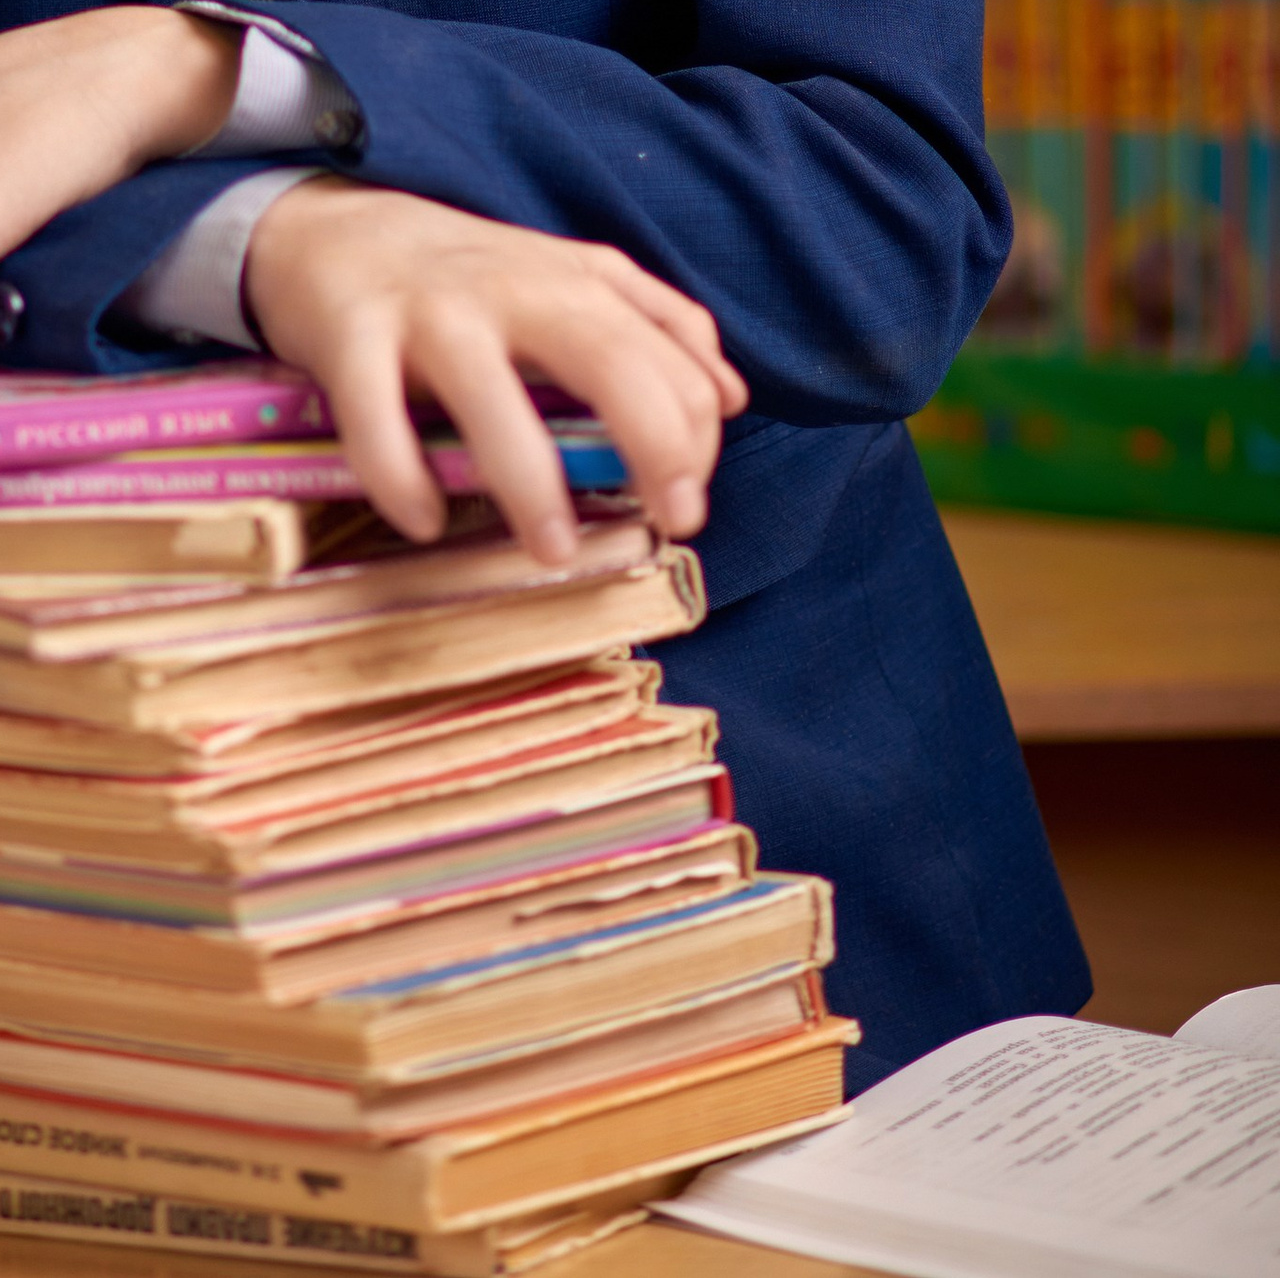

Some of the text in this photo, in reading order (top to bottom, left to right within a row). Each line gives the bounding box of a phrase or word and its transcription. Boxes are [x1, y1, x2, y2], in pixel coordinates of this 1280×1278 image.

[15, 413, 149, 449] РУССКИЙ
[159, 408, 235, 436] ЯЗЫК
[49, 1127, 128, 1158] ЖИВОЕ
[168, 1204, 274, 1245] ПРАВИЛ
